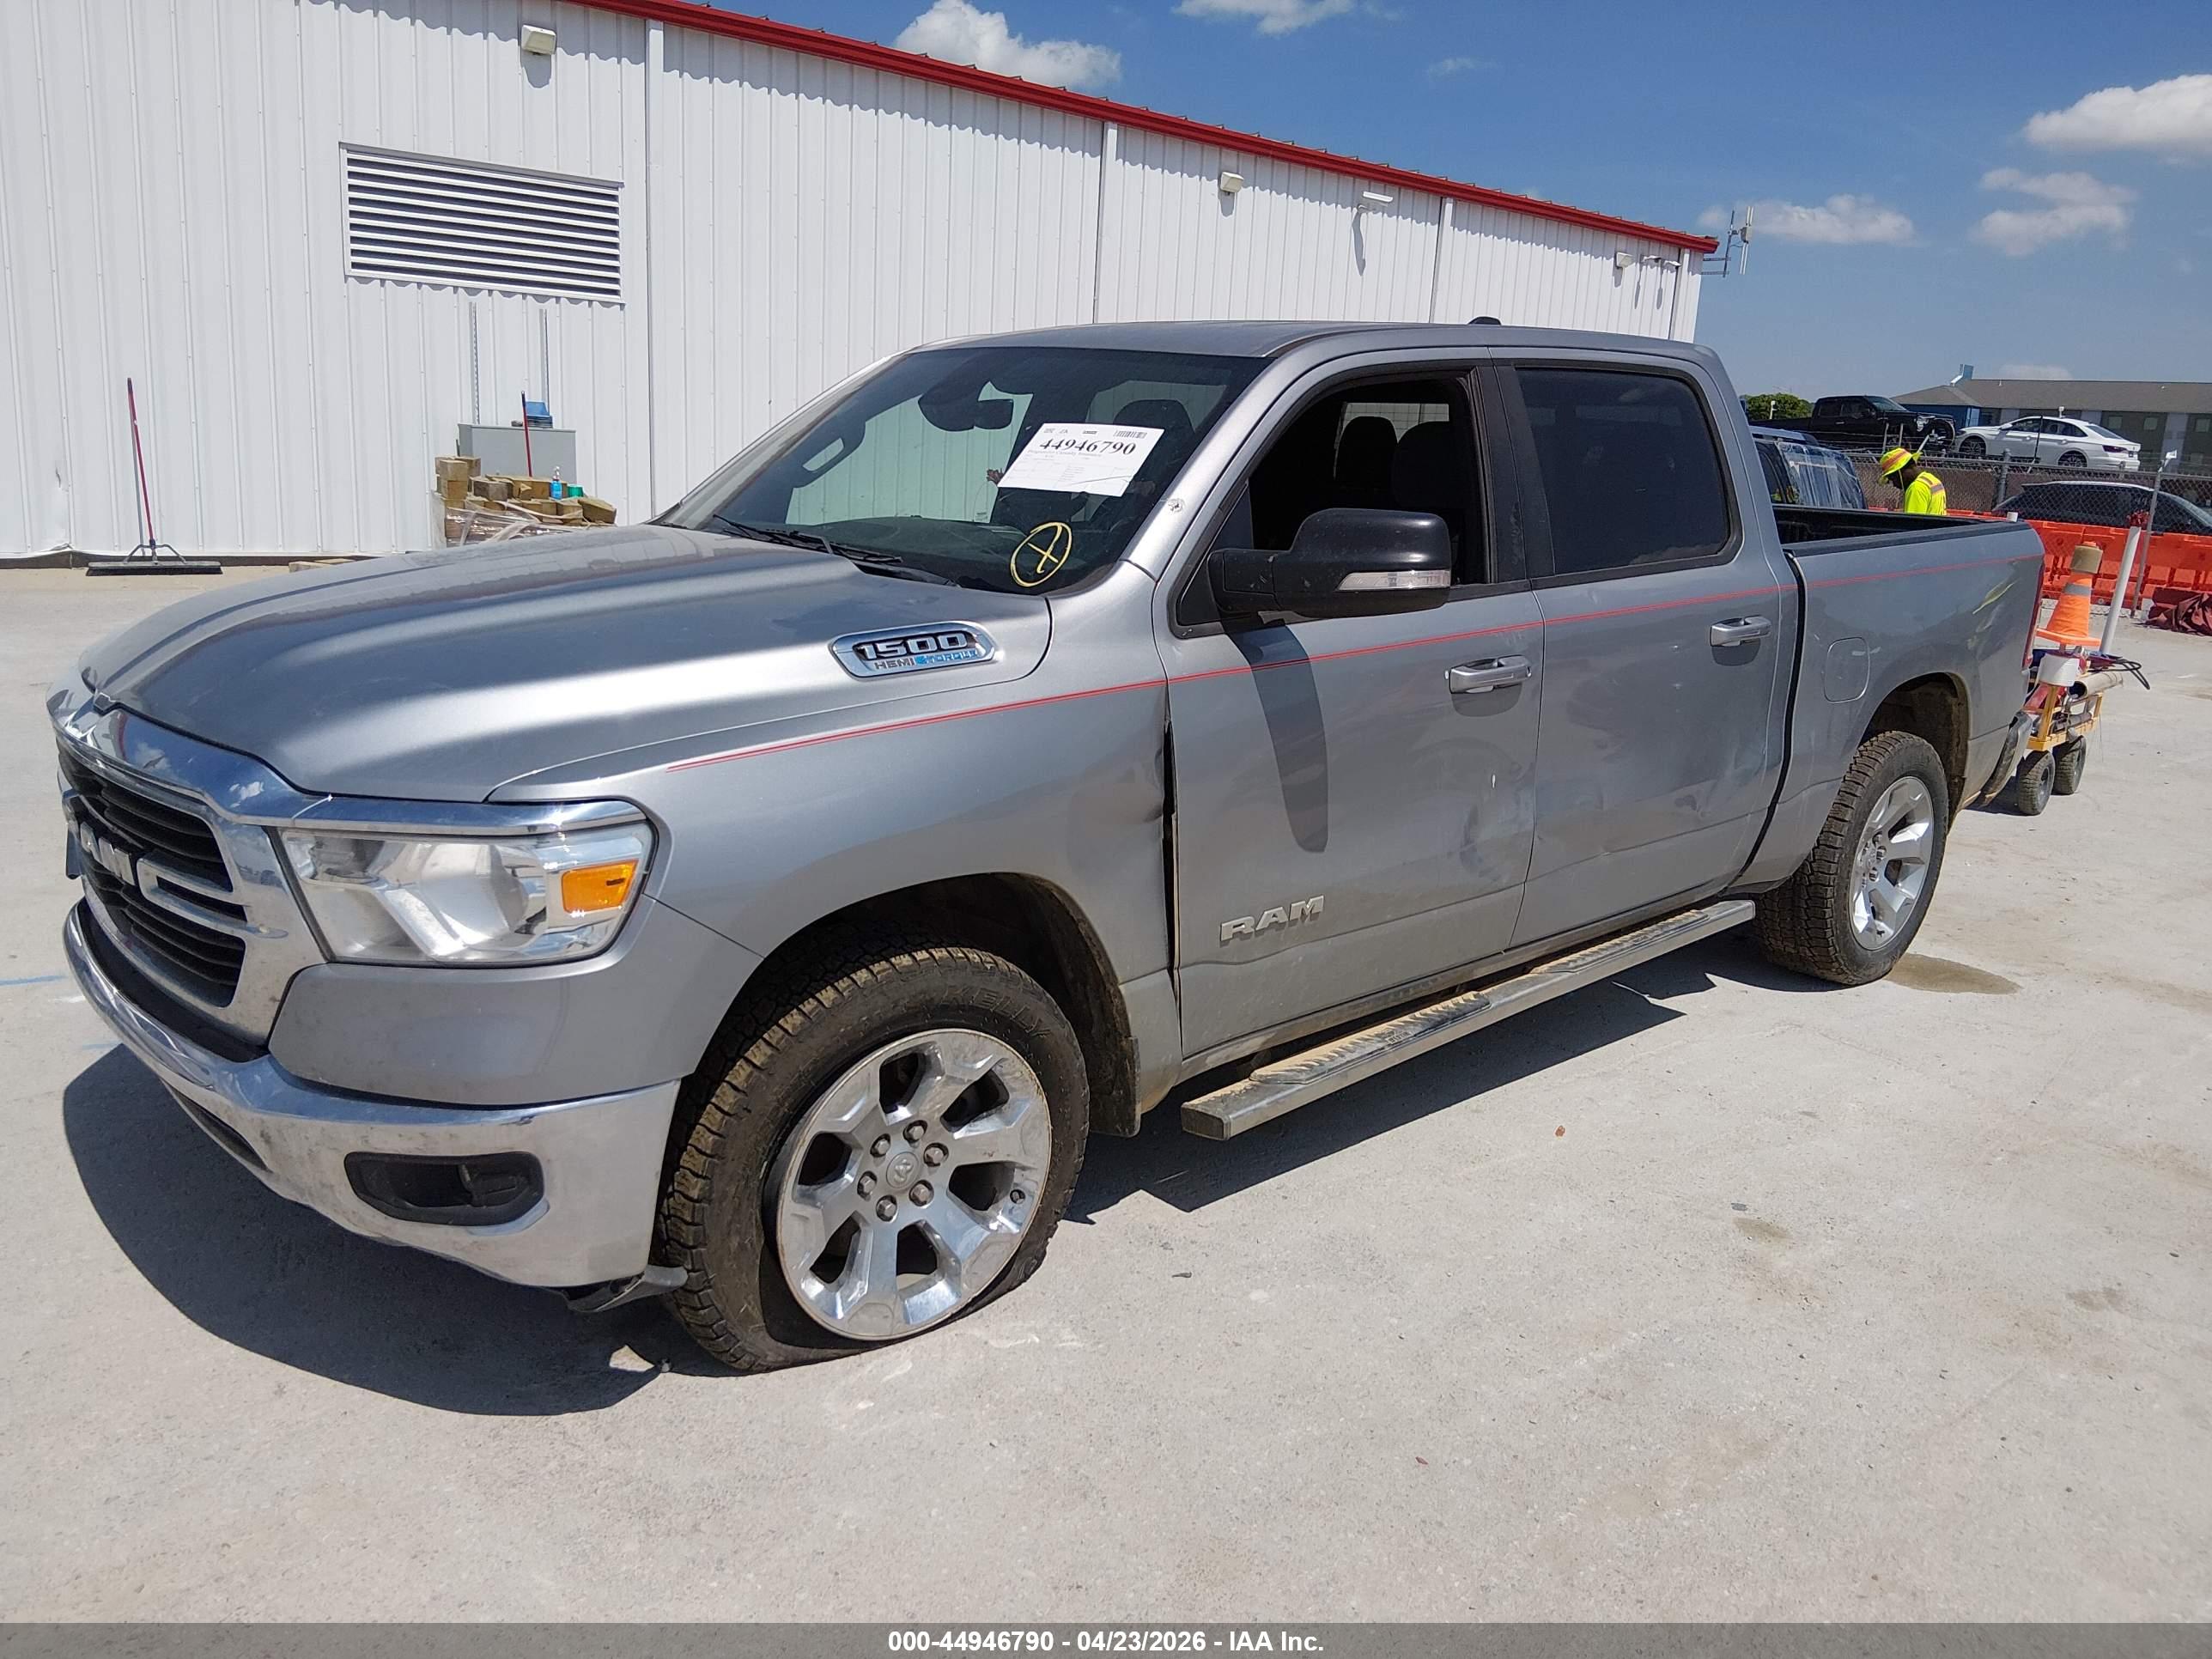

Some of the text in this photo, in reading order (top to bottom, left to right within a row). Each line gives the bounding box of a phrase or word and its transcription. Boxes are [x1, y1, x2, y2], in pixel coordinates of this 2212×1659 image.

[1040, 438, 1137, 455] 44946790
[860, 633, 968, 659] 1500
[874, 657, 915, 670] HEMI
[1220, 895, 1324, 942] RAM
[941, 985, 1051, 1038] KELLY
